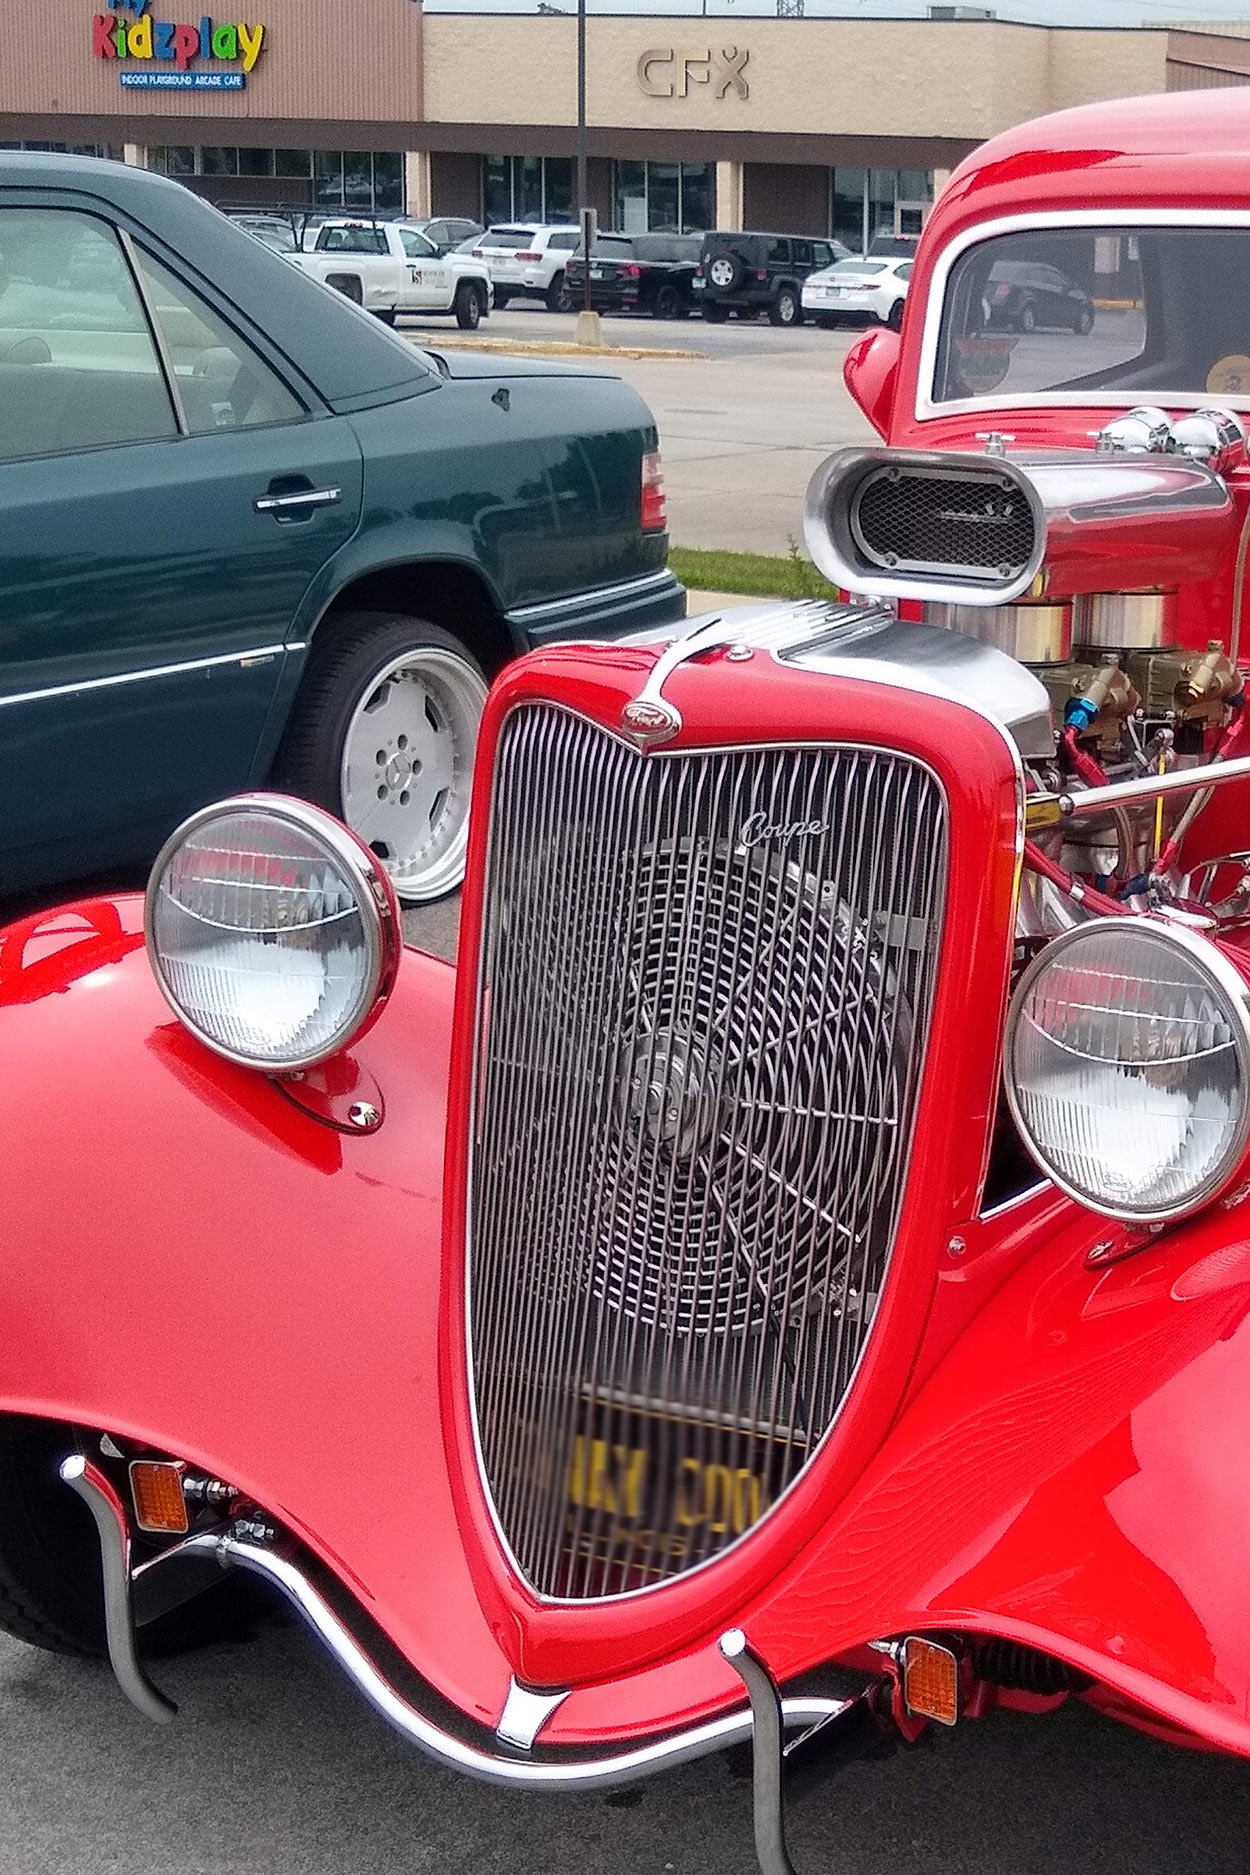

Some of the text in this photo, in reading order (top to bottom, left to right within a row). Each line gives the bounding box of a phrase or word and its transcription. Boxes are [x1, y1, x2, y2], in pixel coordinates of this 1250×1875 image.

[94, 14, 265, 72] Kidzplay
[121, 74, 242, 86] INDOOR PLAYGROUND ARCADE CAFE
[637, 46, 749, 99] CFX
[625, 706, 665, 726] Ford
[741, 810, 830, 847] Coupe
